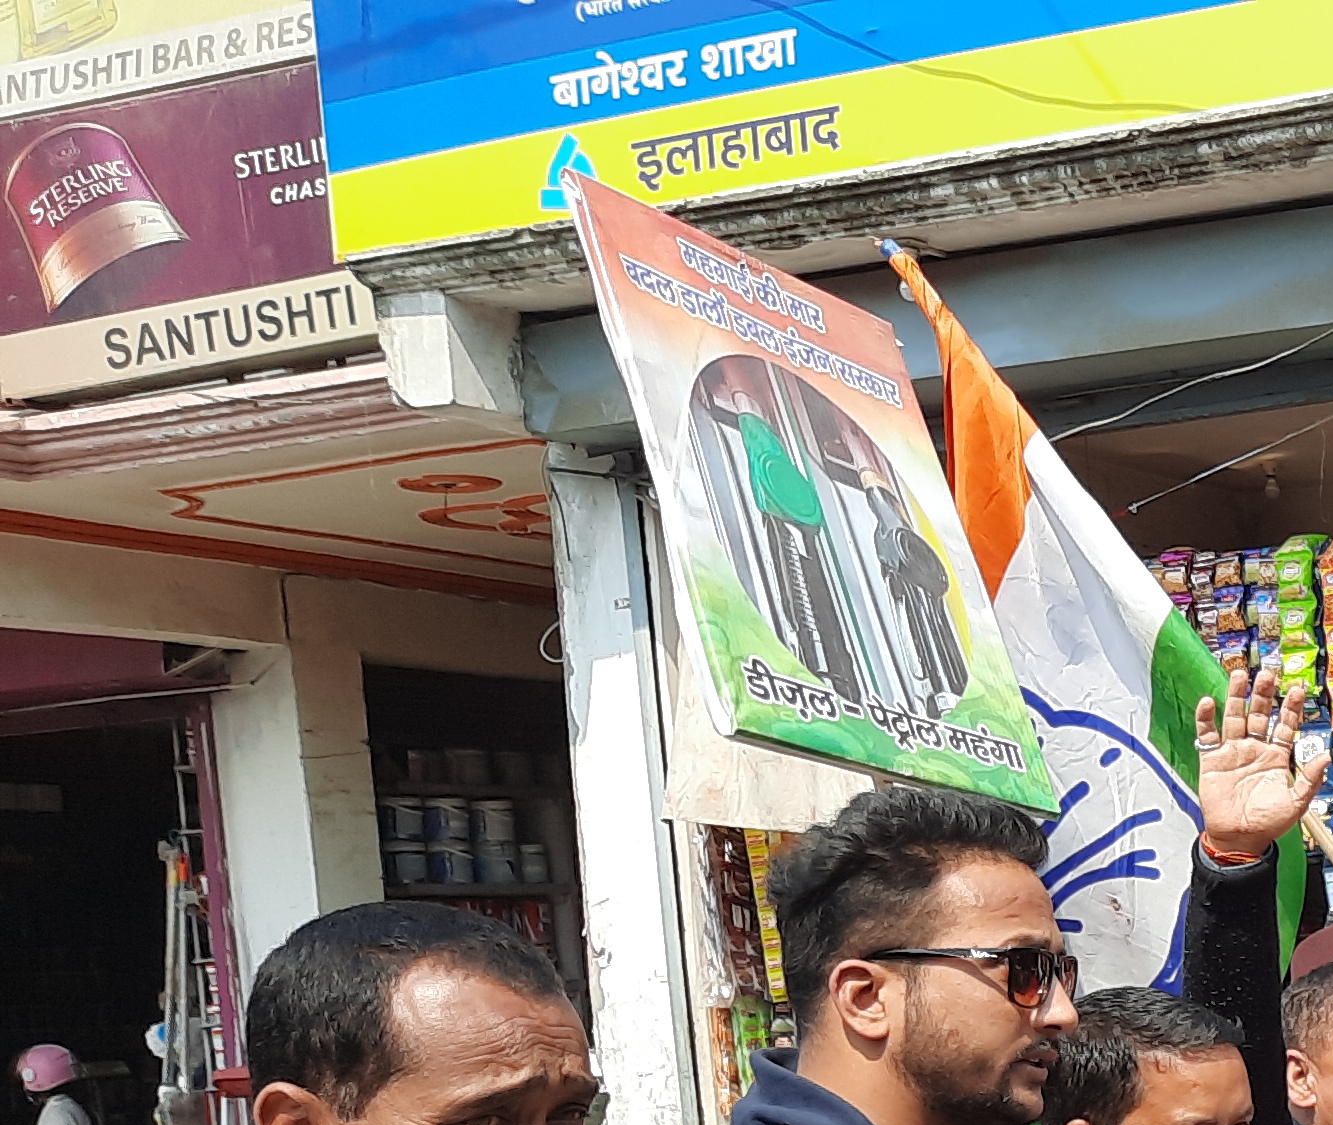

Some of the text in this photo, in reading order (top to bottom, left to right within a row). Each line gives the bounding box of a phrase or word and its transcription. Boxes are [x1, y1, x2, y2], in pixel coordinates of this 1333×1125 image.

[0, 48, 142, 105] NTUSHTI
[152, 34, 216, 75] BAR
[224, 27, 247, 60] &
[550, 28, 797, 107] बागेश्वर शाखा
[630, 105, 840, 191] इलाहाबाद
[29, 159, 133, 225] STERLING
[47, 177, 128, 227] RESERVE
[104, 283, 359, 371] SANTUSHTI
[752, 272, 786, 315] की
[783, 291, 826, 334] मार
[778, 325, 838, 380] इंजन
[834, 356, 904, 409] सरकार
[866, 694, 942, 751] पेट्रोल
[944, 727, 1025, 770] महंगा
